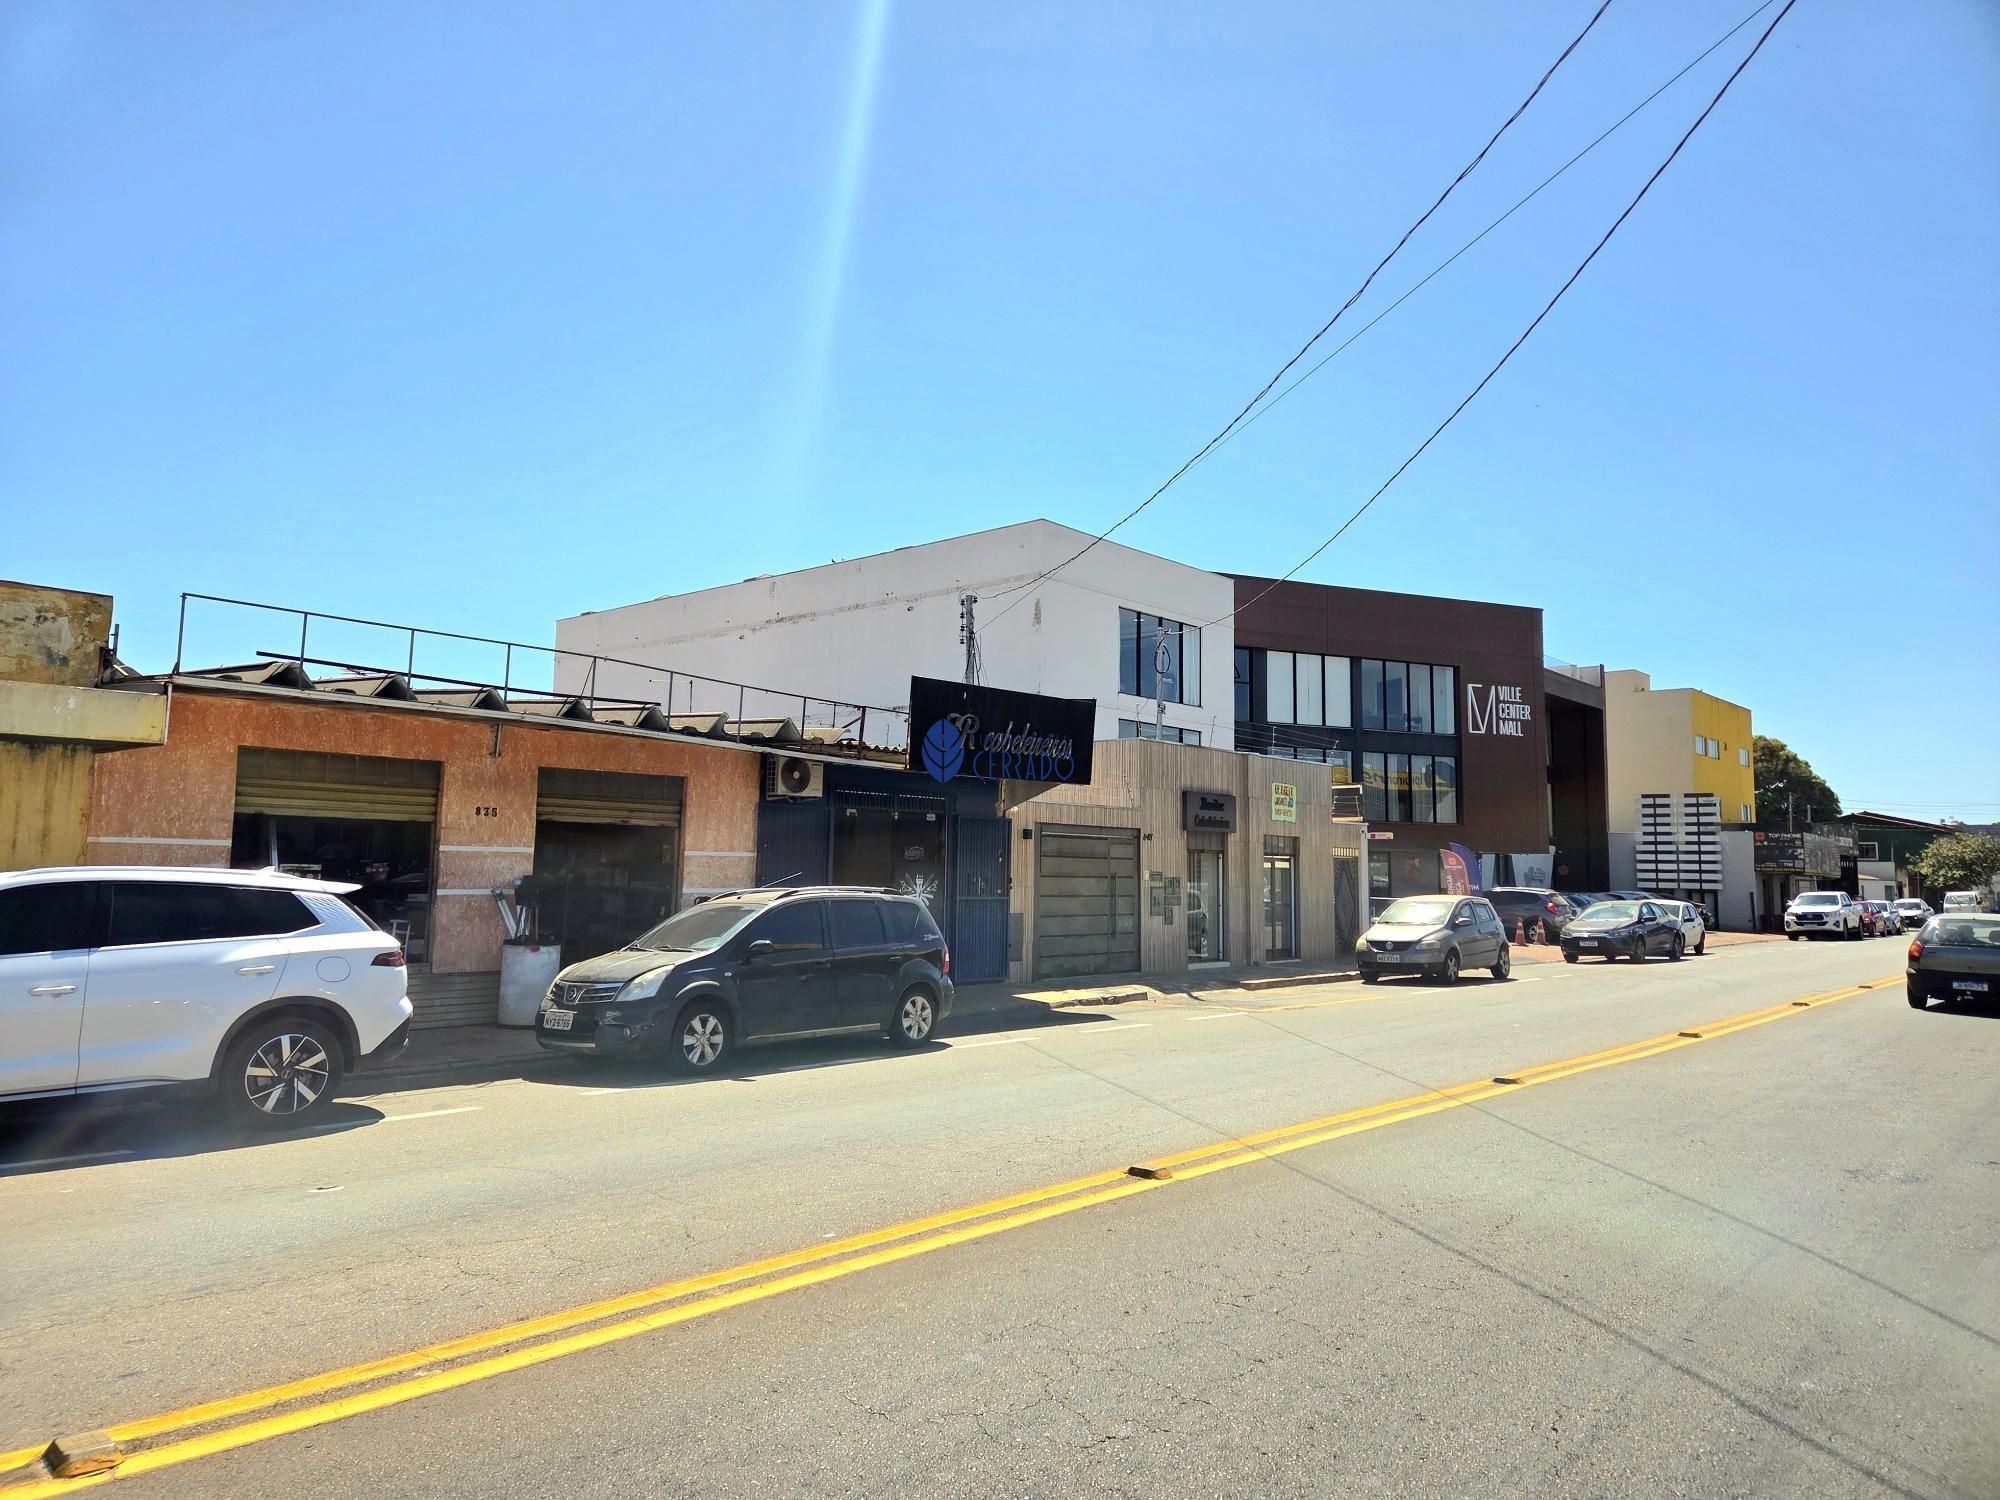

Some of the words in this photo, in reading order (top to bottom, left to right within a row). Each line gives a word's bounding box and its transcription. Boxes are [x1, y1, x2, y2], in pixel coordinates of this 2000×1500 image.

[1497, 685, 1522, 702] VILLE
[1498, 702, 1531, 721] CENTER
[1498, 719, 1524, 737] MALL
[972, 749, 1076, 782] CERRADO
[475, 806, 498, 818] 835
